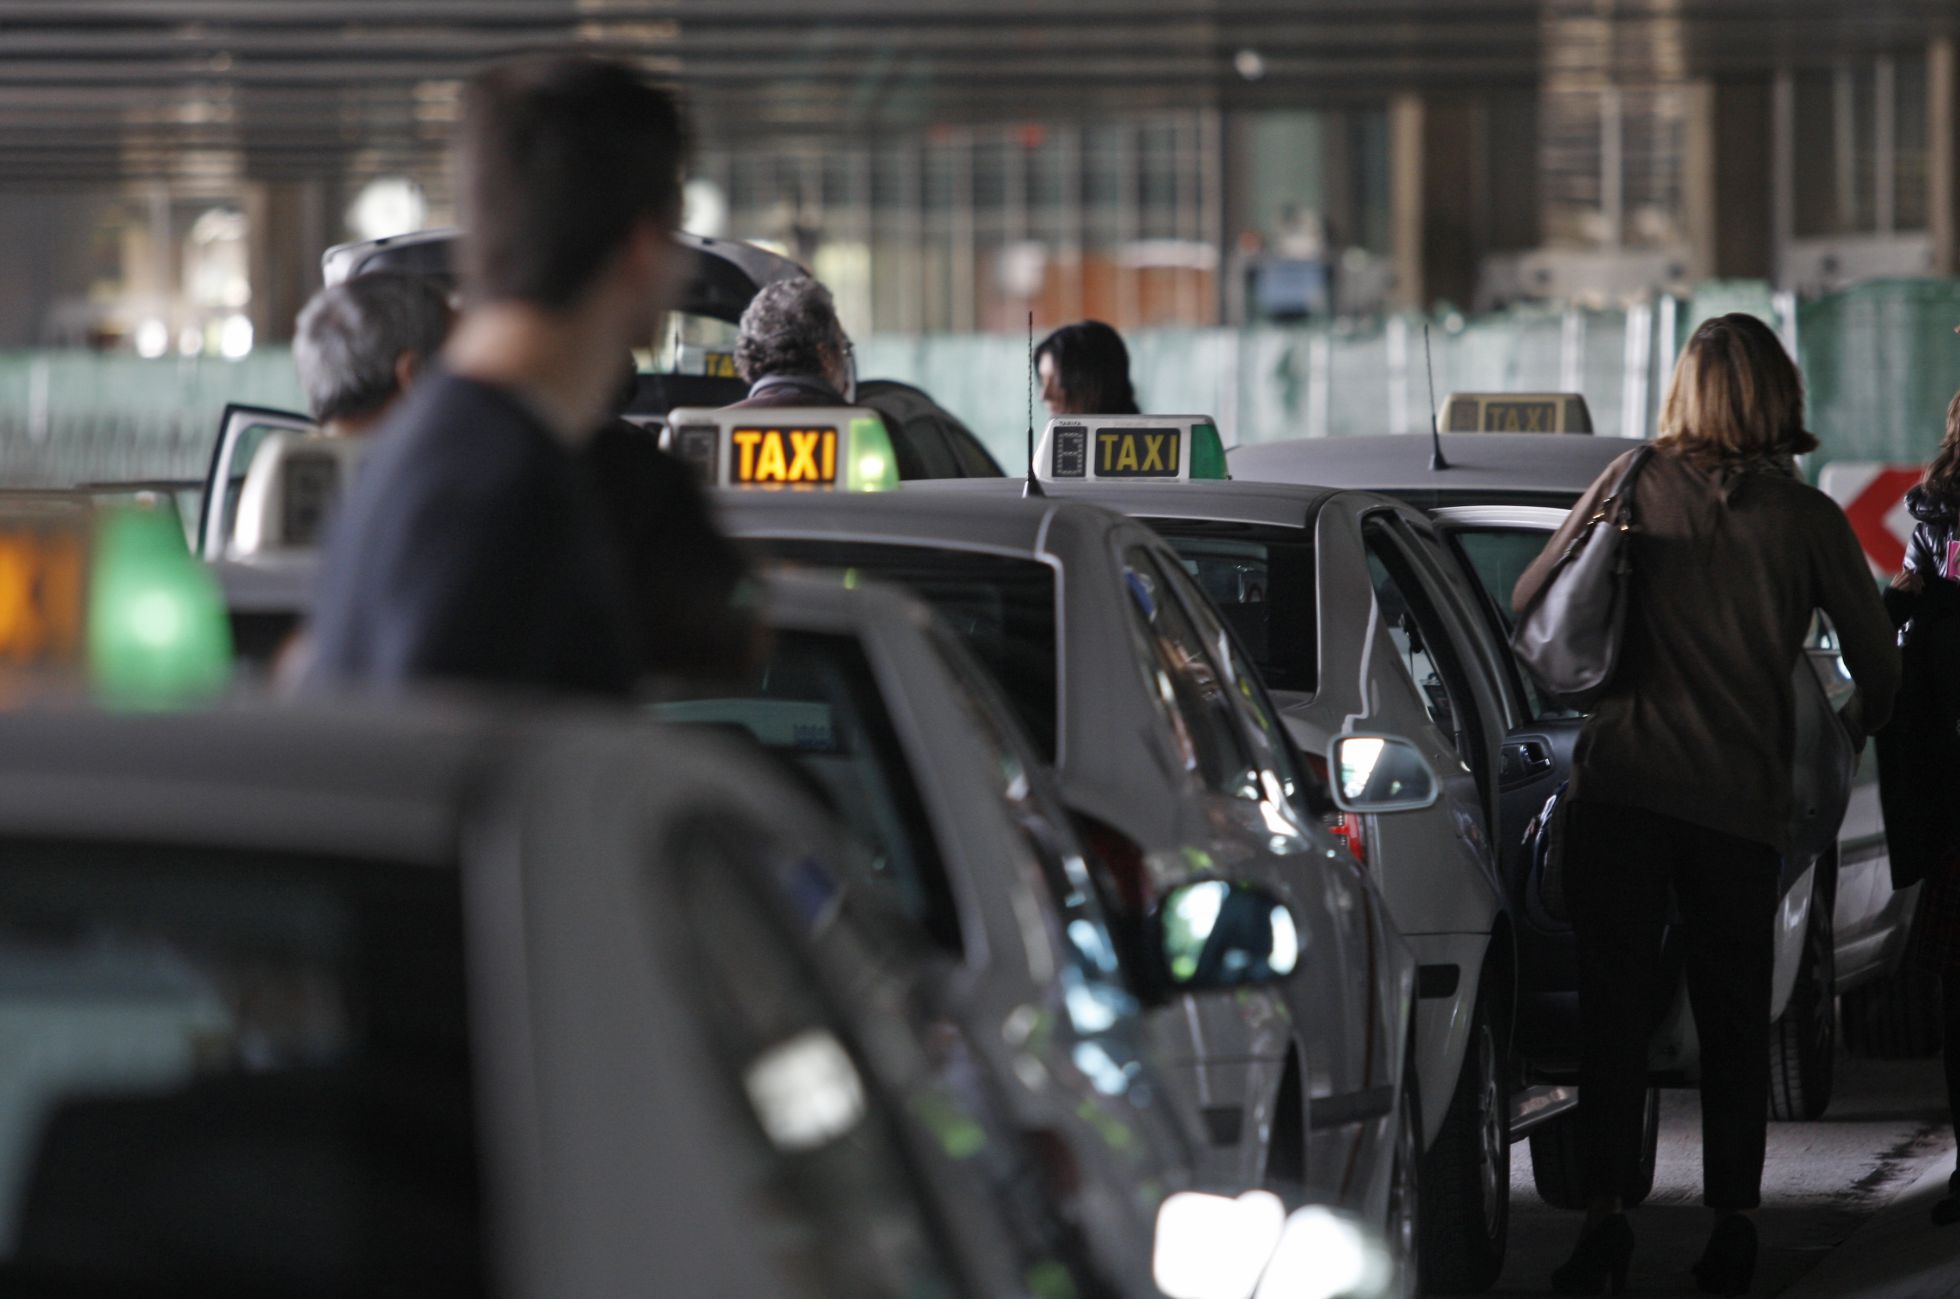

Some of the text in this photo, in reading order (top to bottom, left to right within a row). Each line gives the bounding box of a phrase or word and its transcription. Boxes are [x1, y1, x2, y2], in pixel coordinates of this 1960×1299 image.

[704, 352, 736, 377] TA
[1488, 407, 1554, 432] TAXI
[733, 429, 836, 481] TAXI
[1098, 433, 1178, 471] TAXI
